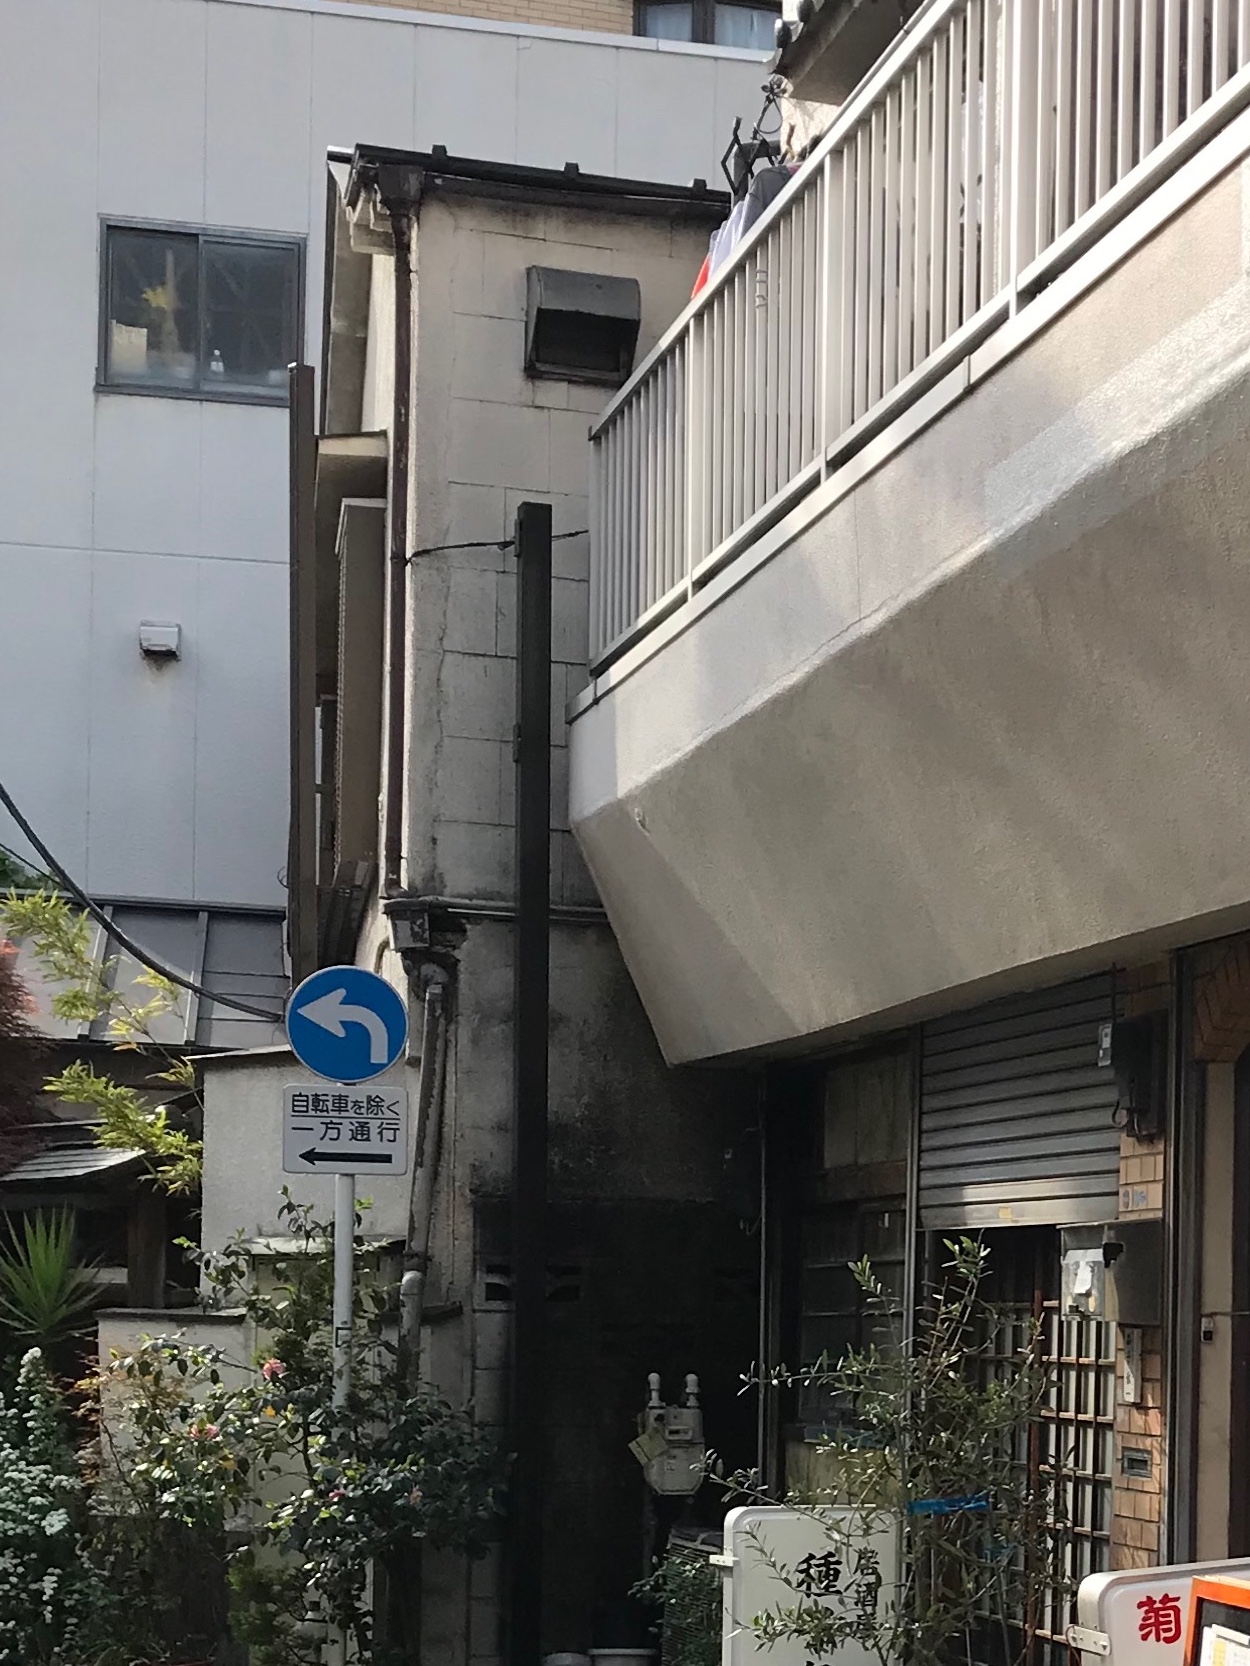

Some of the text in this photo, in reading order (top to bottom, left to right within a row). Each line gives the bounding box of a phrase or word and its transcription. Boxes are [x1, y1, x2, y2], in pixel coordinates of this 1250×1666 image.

[291, 1092, 400, 1116] 自転車を除く
[291, 1120, 400, 1142] 一方通行
